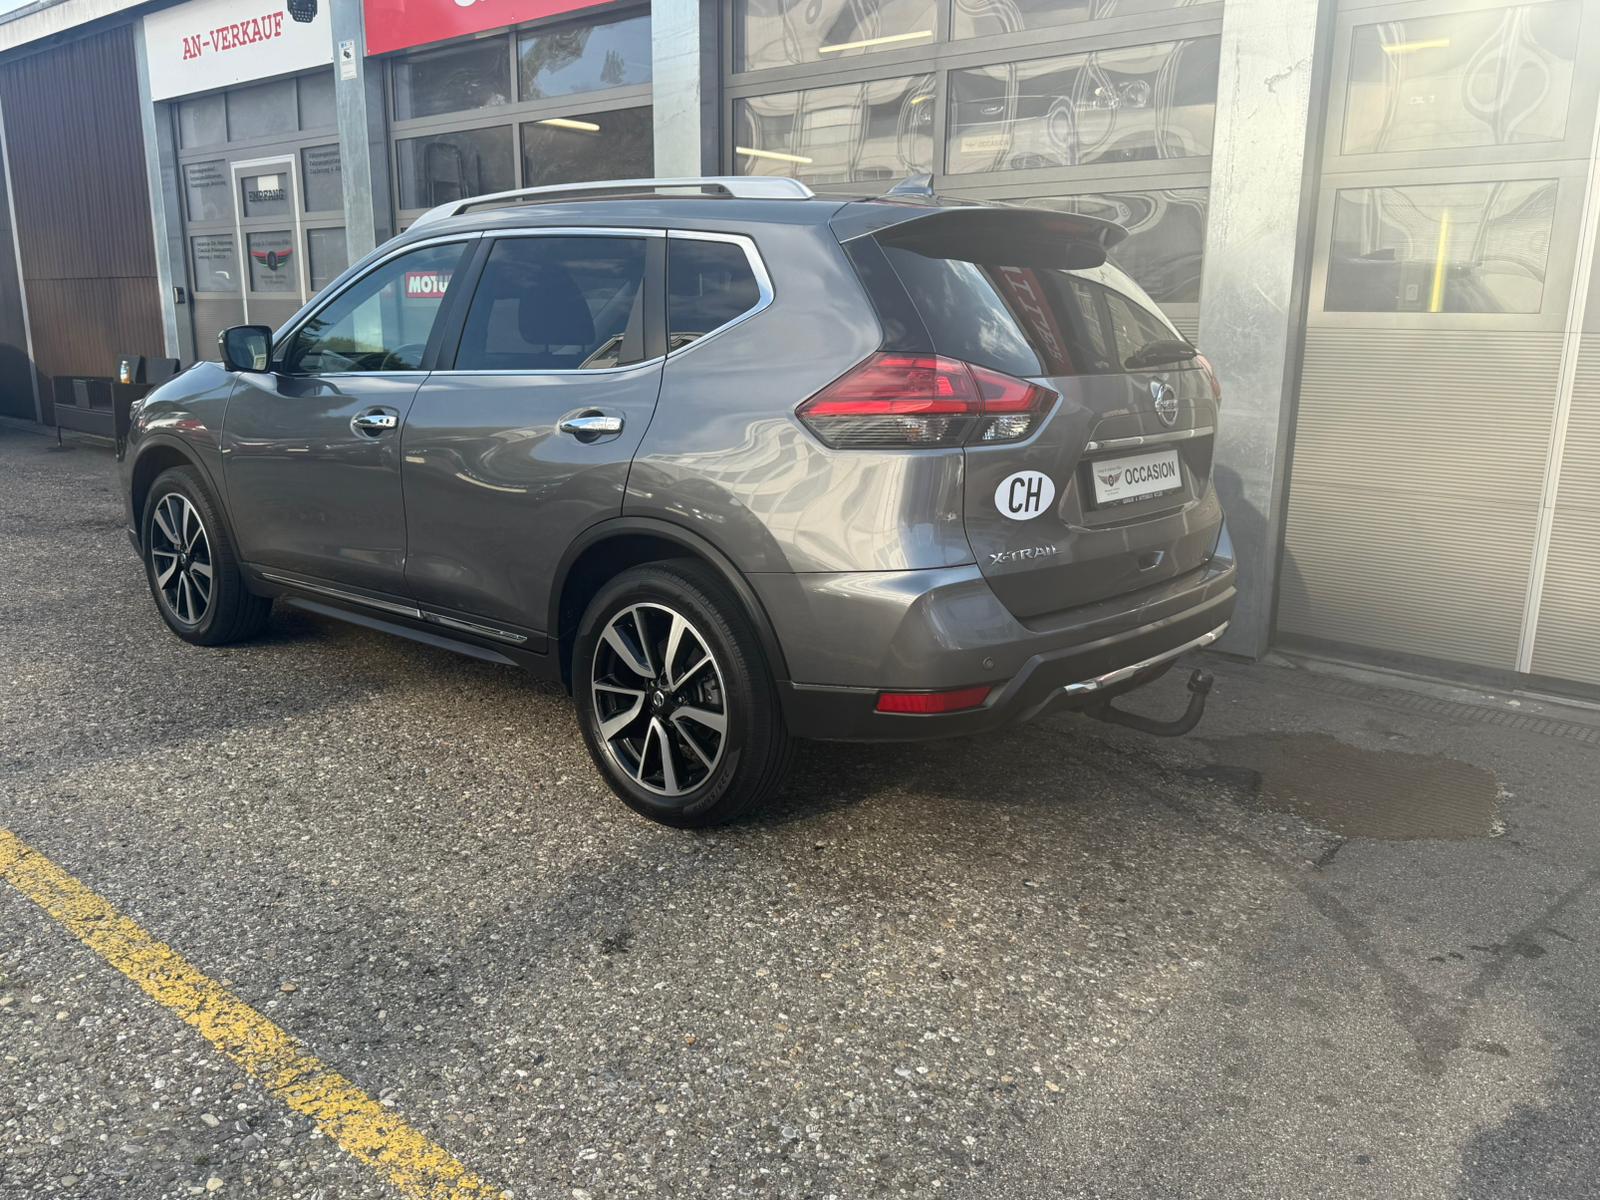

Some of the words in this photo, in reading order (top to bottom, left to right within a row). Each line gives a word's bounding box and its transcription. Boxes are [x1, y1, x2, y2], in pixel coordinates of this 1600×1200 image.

[183, 11, 284, 60] AN-VERKAUF
[408, 275, 452, 293] MOTU
[1125, 461, 1176, 485] OCCASION
[1008, 477, 1043, 513] CH
[989, 544, 1064, 565] X-TRAIL
